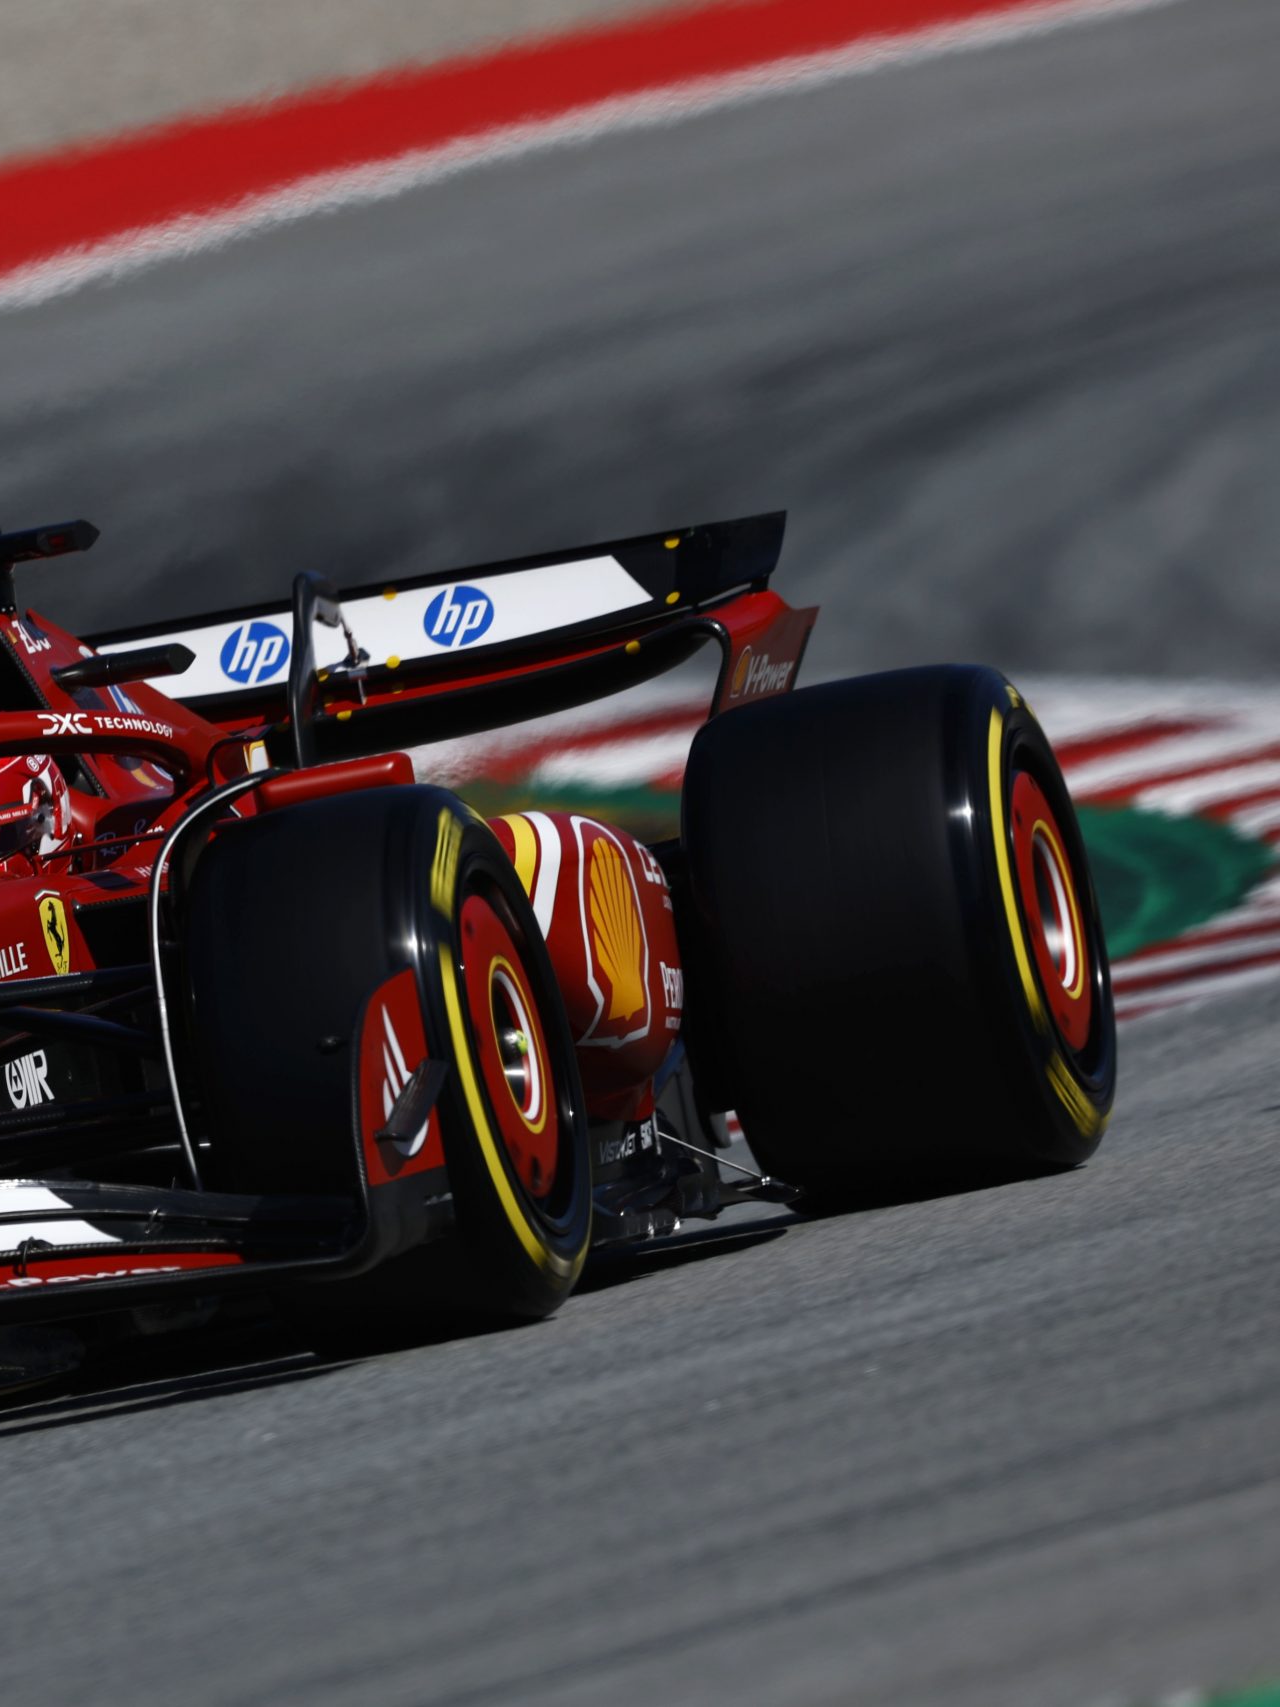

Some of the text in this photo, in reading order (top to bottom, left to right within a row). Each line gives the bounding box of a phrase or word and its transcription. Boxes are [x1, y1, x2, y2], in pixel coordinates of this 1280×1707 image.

[427, 585, 491, 647] hp
[224, 622, 287, 684] hp
[37, 713, 173, 739] DXC TECHNOLOGY
